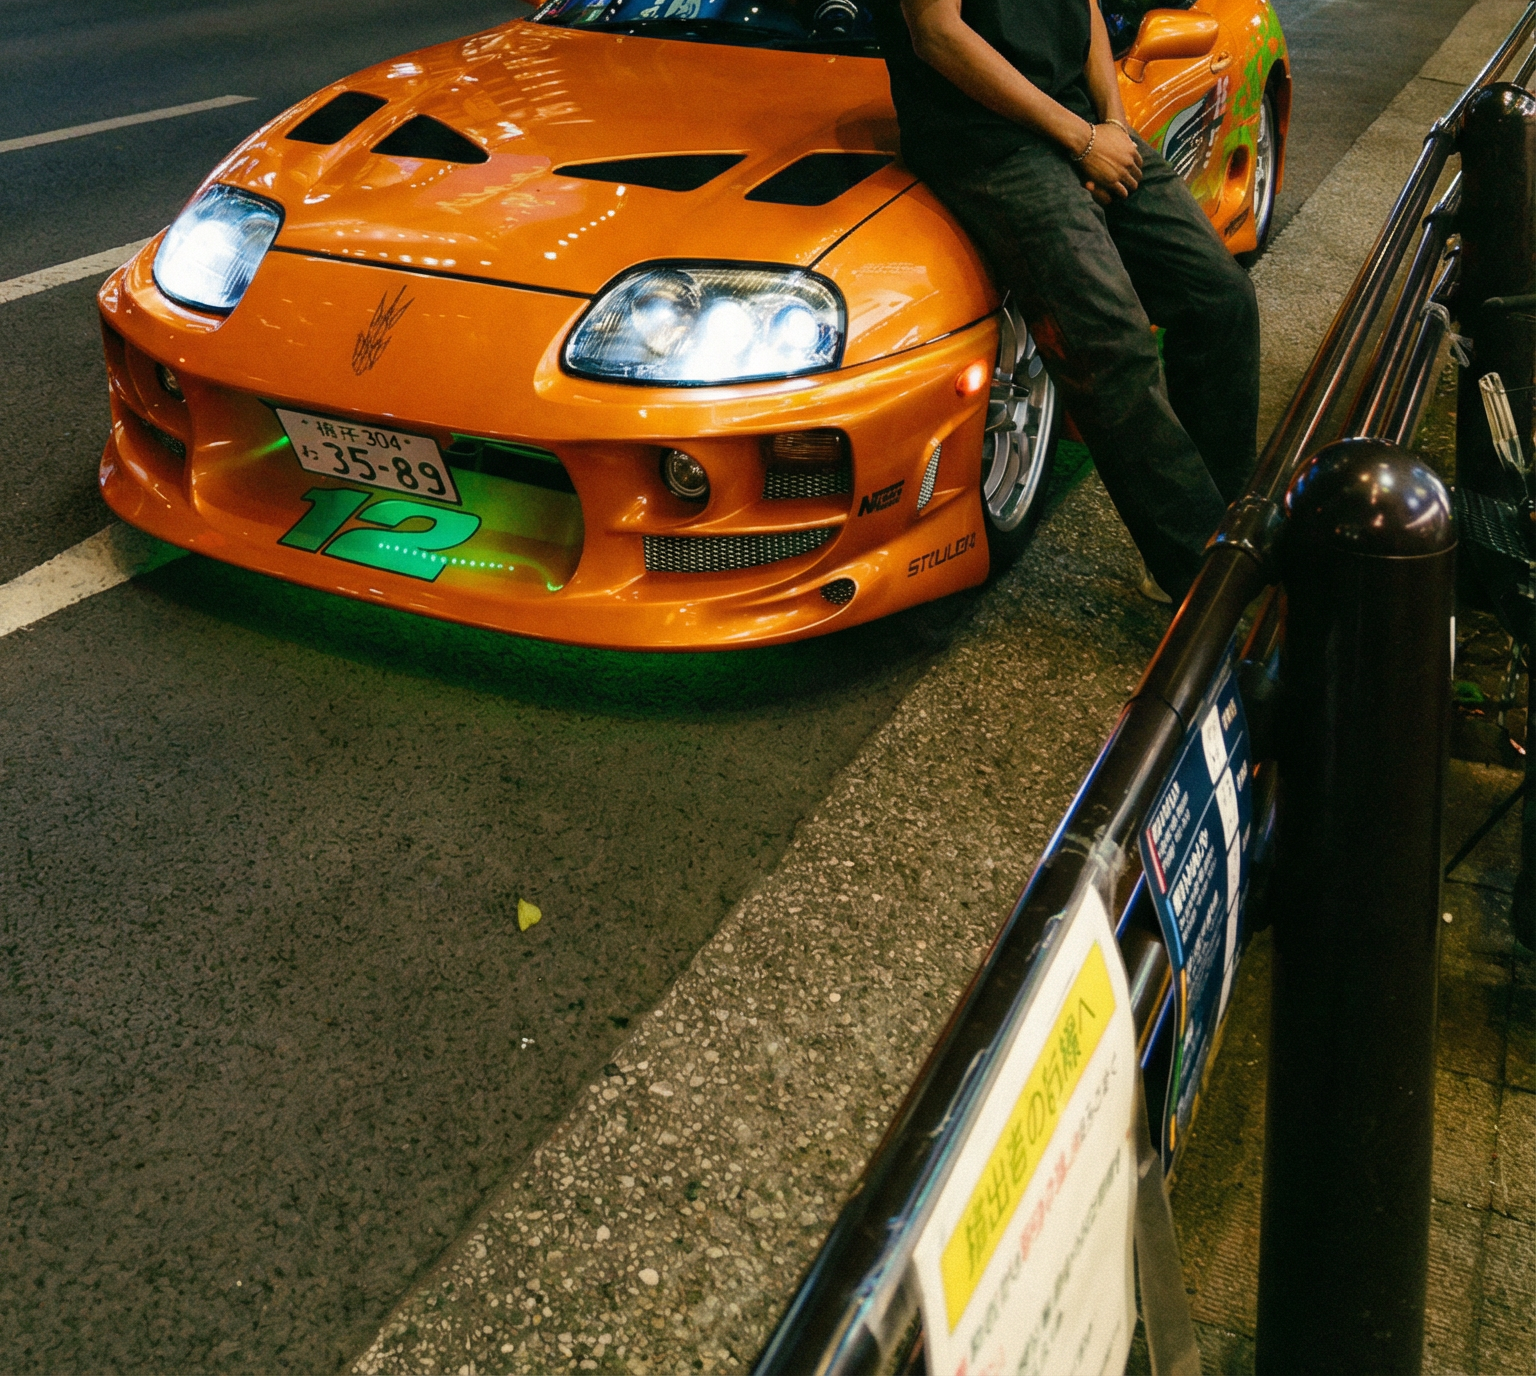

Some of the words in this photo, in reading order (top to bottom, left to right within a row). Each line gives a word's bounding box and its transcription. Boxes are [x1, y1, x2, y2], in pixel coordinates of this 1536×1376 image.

[361, 429, 402, 451] 304
[322, 442, 447, 496] 35-89
[277, 487, 482, 582] 12
